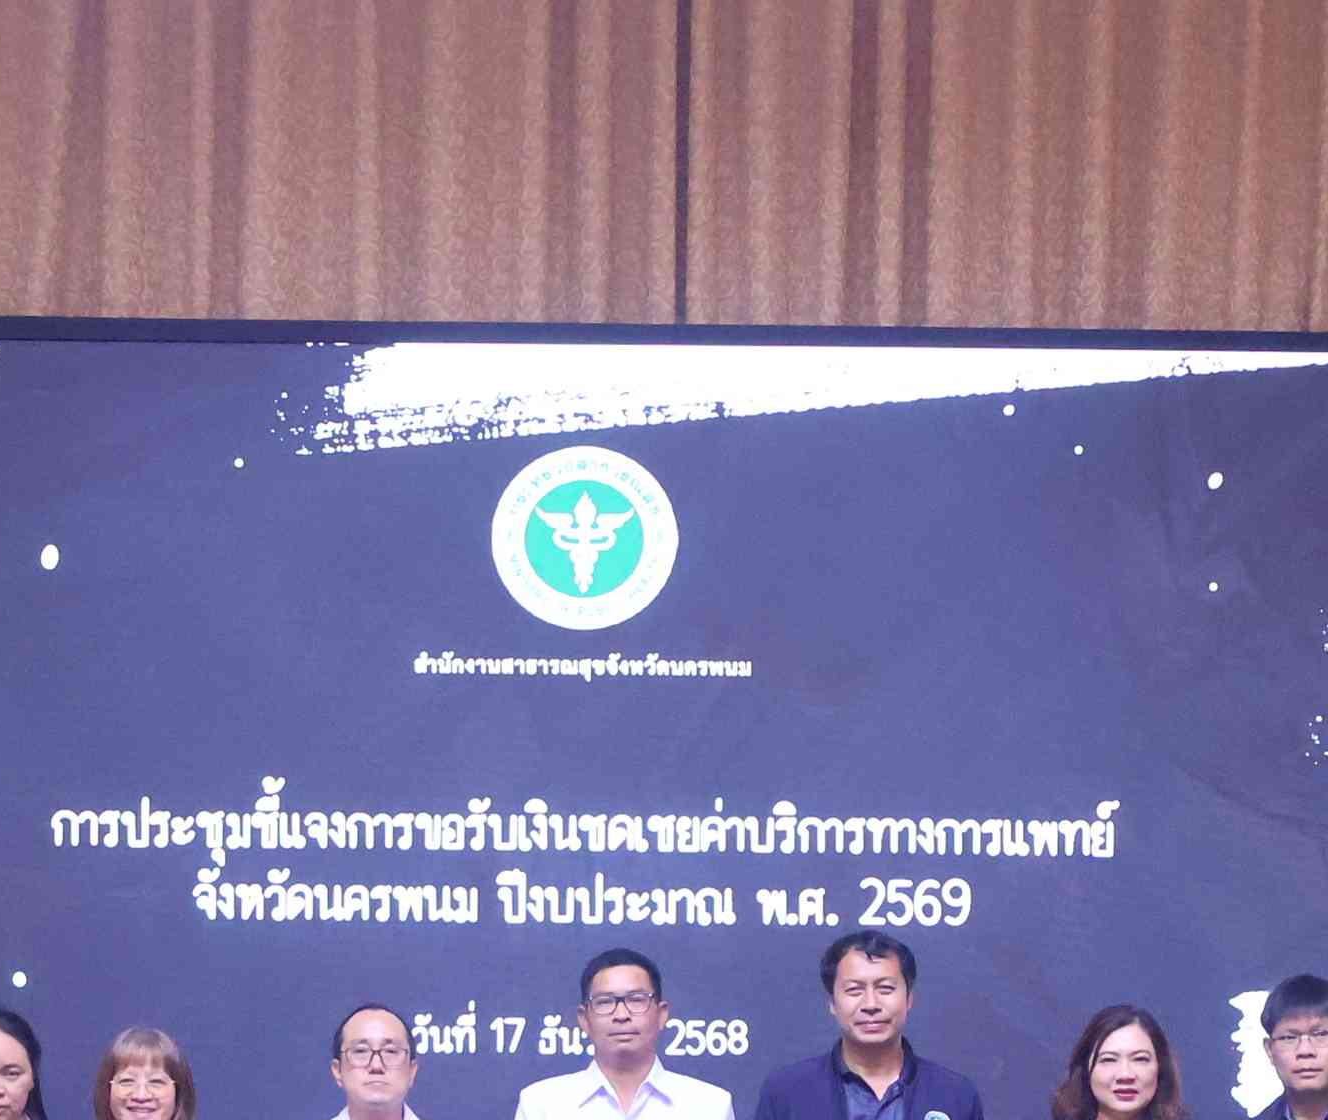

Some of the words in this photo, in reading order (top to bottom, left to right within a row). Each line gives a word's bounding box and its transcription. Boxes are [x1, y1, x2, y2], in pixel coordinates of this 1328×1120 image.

[413, 651, 753, 683] สำนักงานสาธารณสุขจังหวัดนครพนม
[50, 775, 1121, 867] การประชุมชี้แจงการขอรับเงินชดเชยค่าบริการทางการแพทย์
[192, 867, 479, 924] จังหวัดนครพนม
[495, 868, 737, 927] ปีงบประมาณ
[756, 887, 840, 927] พ.ศ.
[858, 877, 972, 928] 2569
[411, 999, 477, 1054] วันที่
[489, 1017, 526, 1053] 17
[664, 1018, 749, 1056] 2568
